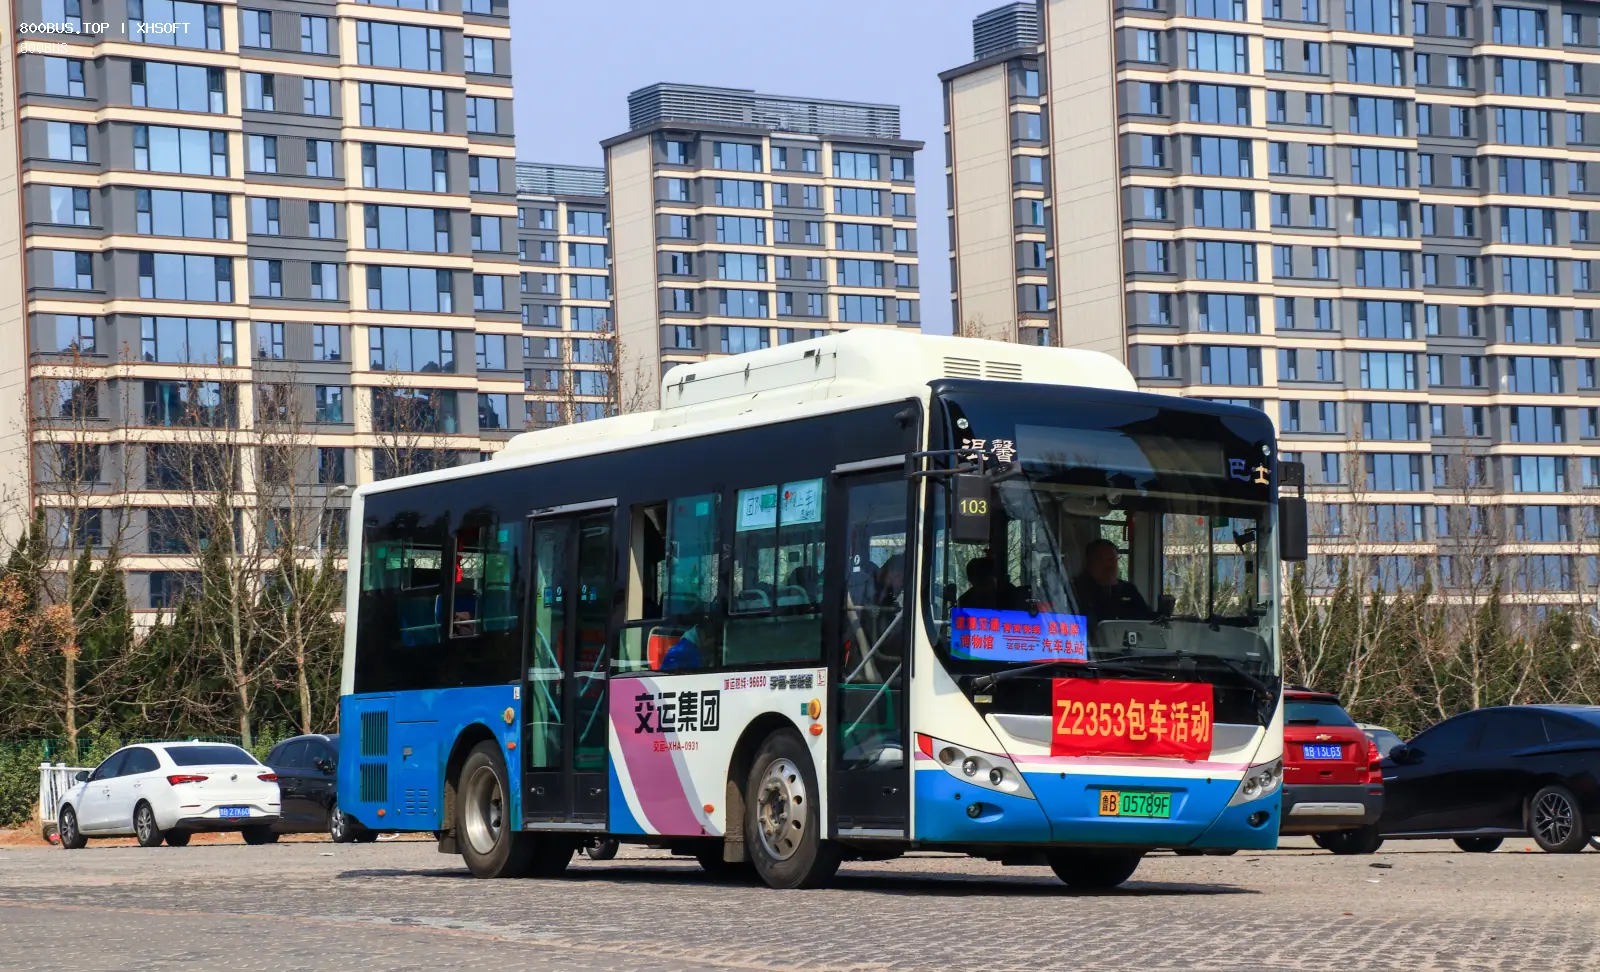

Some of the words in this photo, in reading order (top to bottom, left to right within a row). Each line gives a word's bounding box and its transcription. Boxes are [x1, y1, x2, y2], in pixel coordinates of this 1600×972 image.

[1228, 458, 1271, 486] 巴士
[960, 499, 987, 514] 103
[960, 634, 994, 650] 博物馆
[1042, 638, 1085, 656] 汽车总站
[634, 689, 721, 734] 交运集团
[1056, 697, 1210, 744] Z2353包车活动
